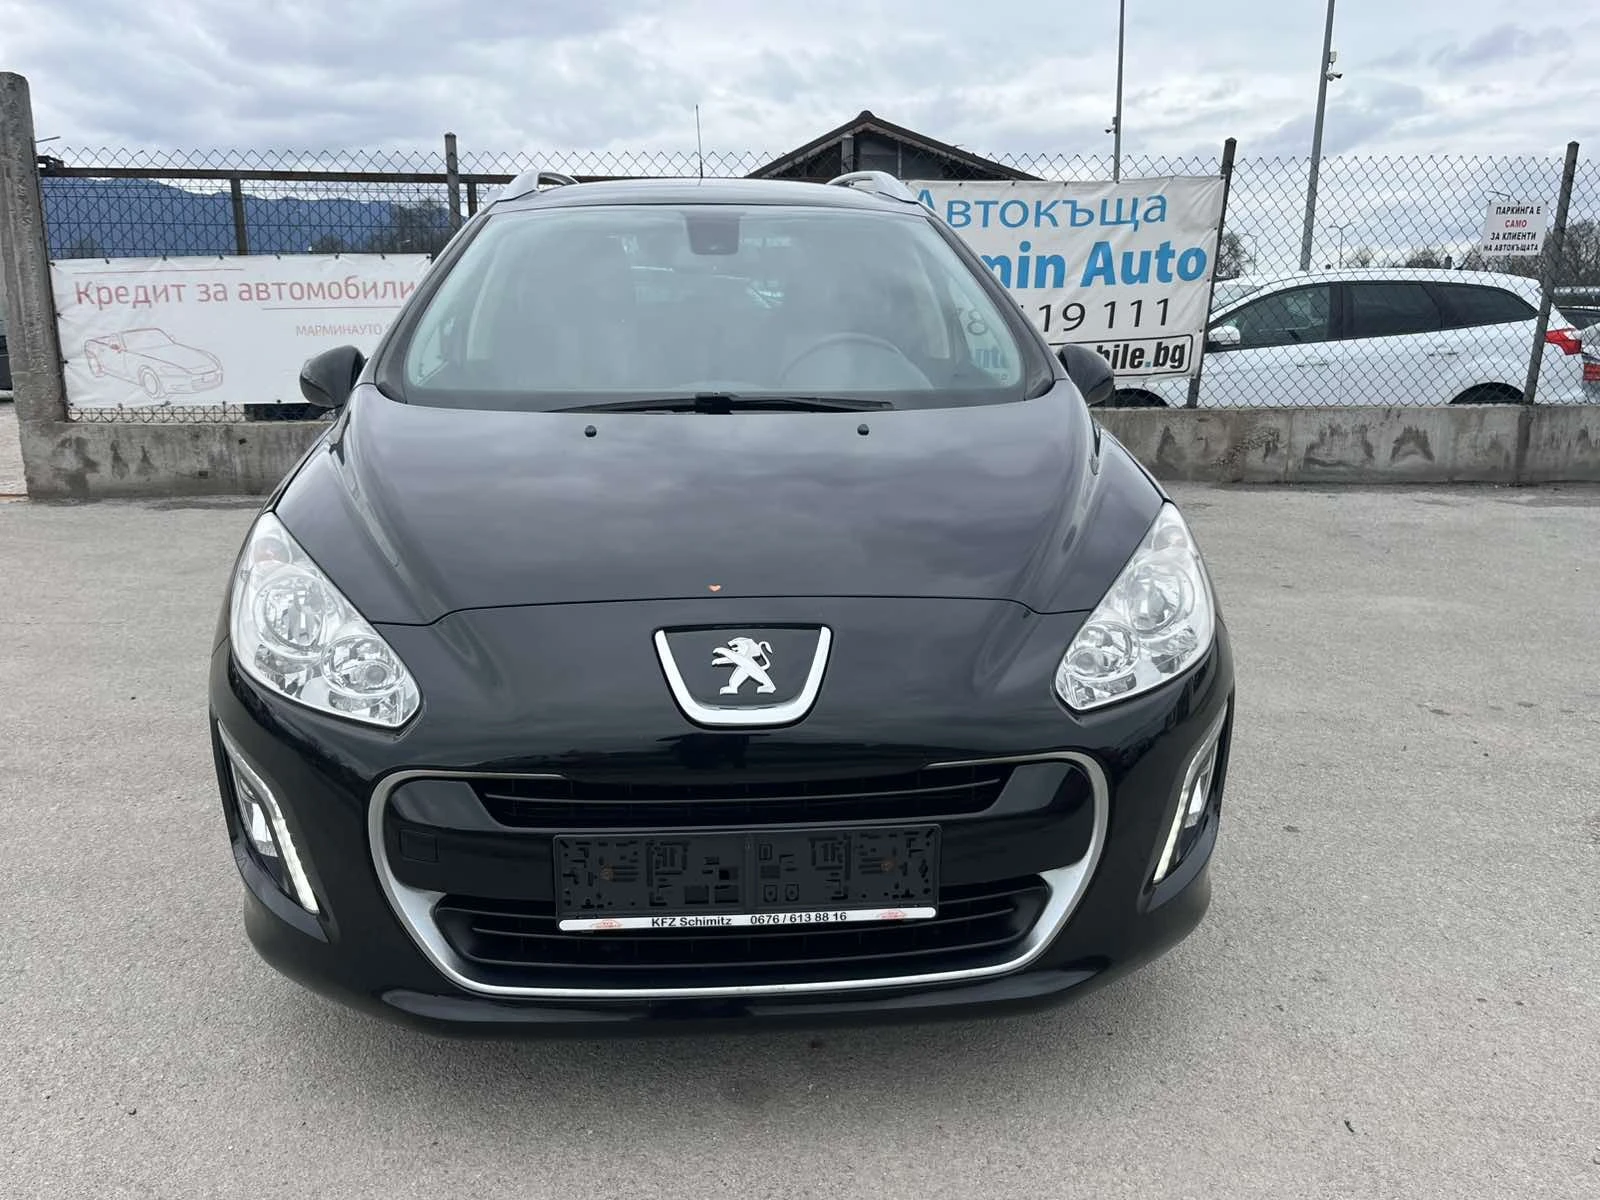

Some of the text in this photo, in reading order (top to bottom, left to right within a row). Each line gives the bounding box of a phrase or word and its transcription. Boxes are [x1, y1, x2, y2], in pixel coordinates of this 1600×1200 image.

[1496, 206, 1541, 215] ПАРКИНГА Е
[1505, 220, 1527, 228] САМО
[1490, 231, 1536, 240] ЗА КЛИЕНТИ
[1494, 243, 1538, 252] АВТОКЪЩАТА
[1079, 240, 1207, 288] Auto
[75, 275, 415, 311] Кредит за автомобили
[1020, 302, 1086, 332] 19
[1104, 298, 1169, 329] 111
[296, 324, 382, 336] МАРМИНАУТО
[651, 918, 676, 927] KFZ
[680, 916, 732, 926] Schimitz
[750, 915, 780, 925] 0676
[790, 913, 811, 923] 613
[815, 913, 829, 922] 88
[834, 912, 847, 921] 16
